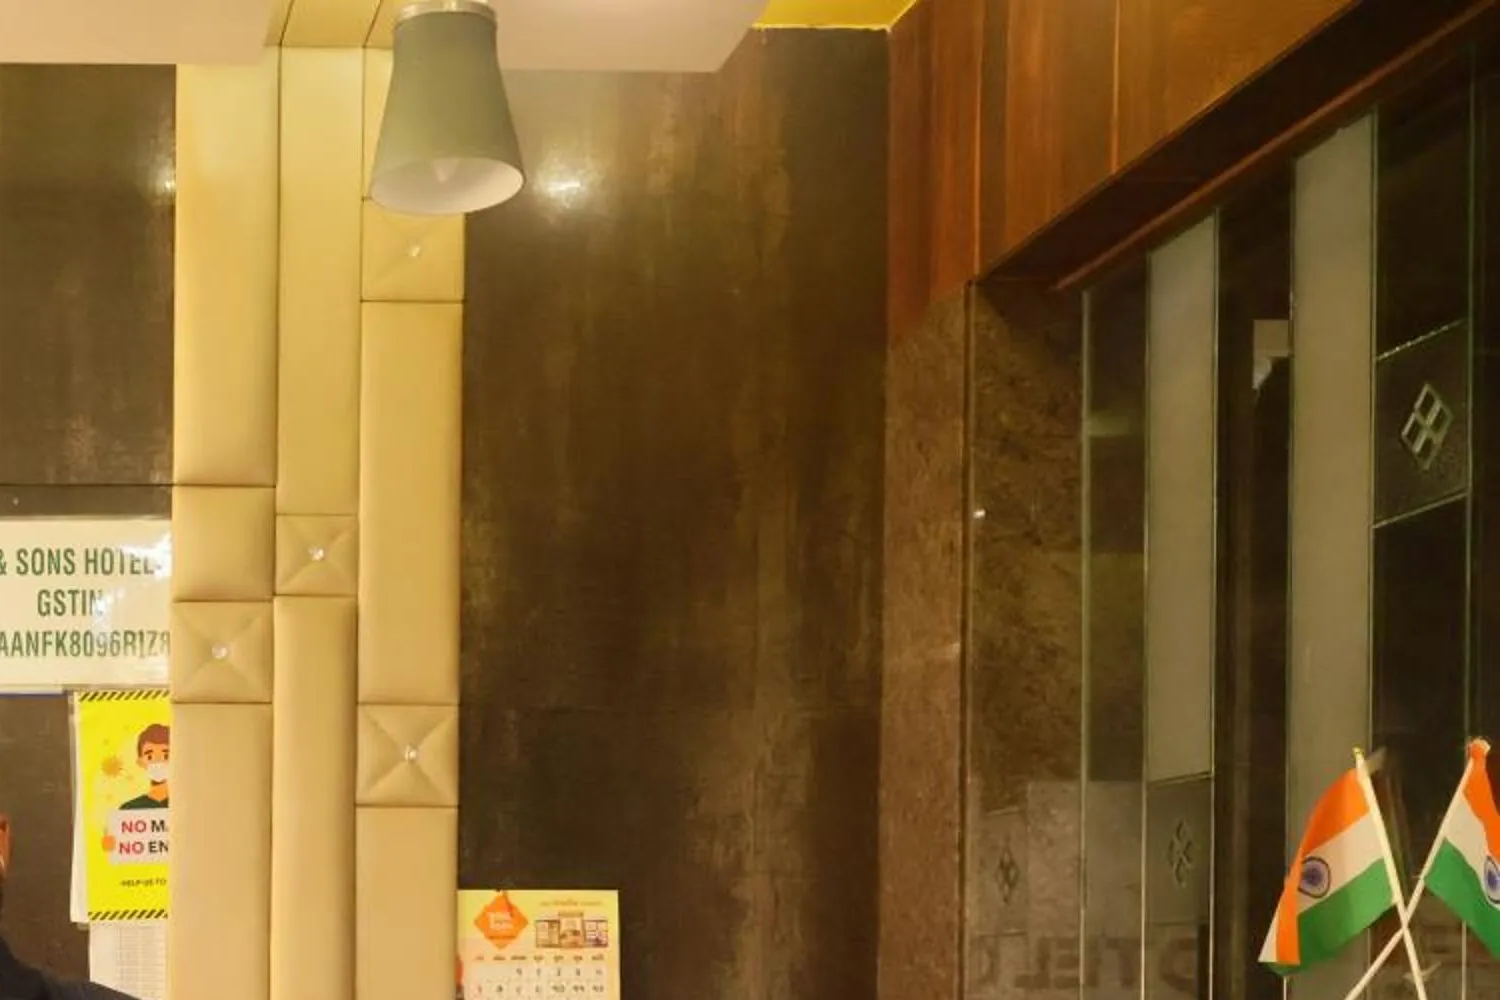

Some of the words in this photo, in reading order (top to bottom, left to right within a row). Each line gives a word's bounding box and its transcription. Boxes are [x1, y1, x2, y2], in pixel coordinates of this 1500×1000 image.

[16, 547, 76, 576] SONS
[84, 548, 162, 576] HOTEL
[121, 820, 147, 833] NO
[150, 819, 168, 833] M
[118, 841, 145, 854] NO
